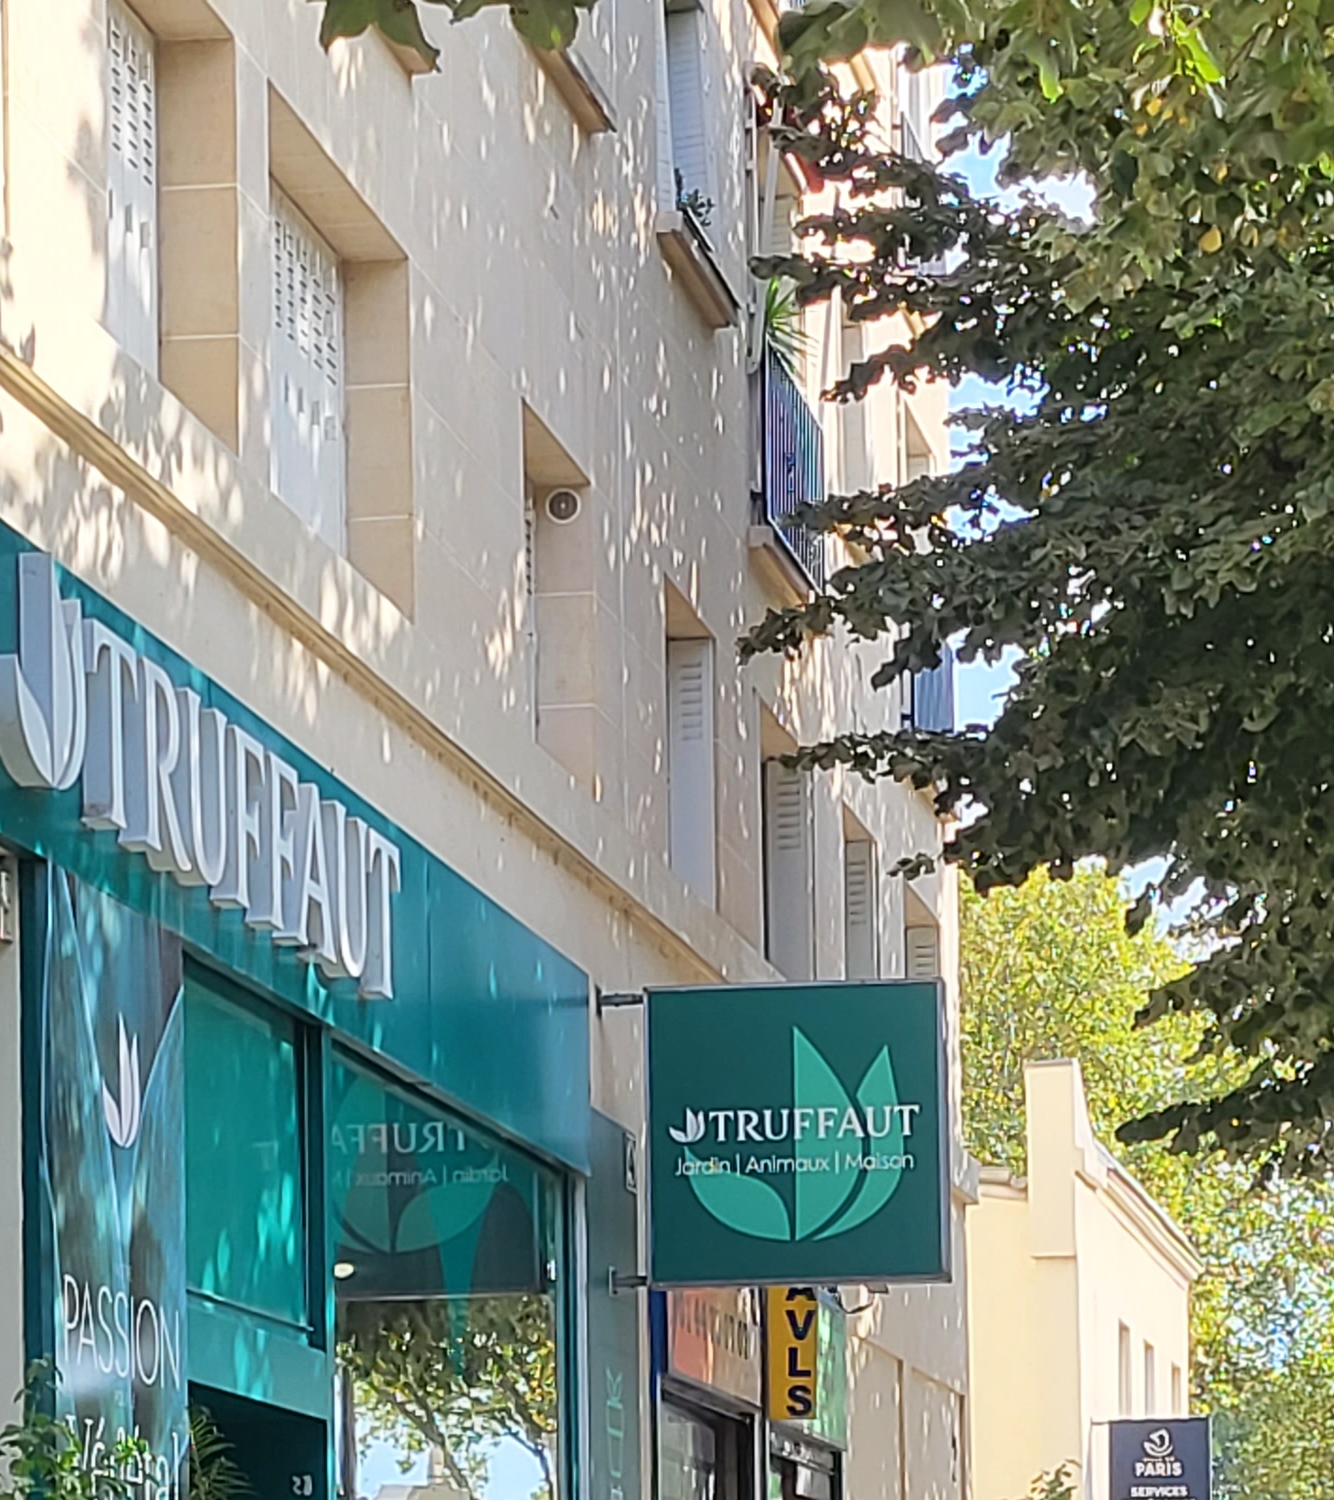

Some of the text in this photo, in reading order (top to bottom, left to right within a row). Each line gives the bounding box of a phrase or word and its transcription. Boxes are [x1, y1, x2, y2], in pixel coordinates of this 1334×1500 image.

[81, 617, 401, 1000] TRUFFAUT
[709, 1104, 921, 1142] TRUFFAUT
[675, 1155, 731, 1176] Jardin
[745, 1155, 830, 1175] Animaux
[844, 1153, 915, 1172] Maison
[63, 1273, 180, 1391] PASSION
[1134, 1461, 1183, 1477] PARIS
[1130, 1485, 1189, 1498] SERVICES
